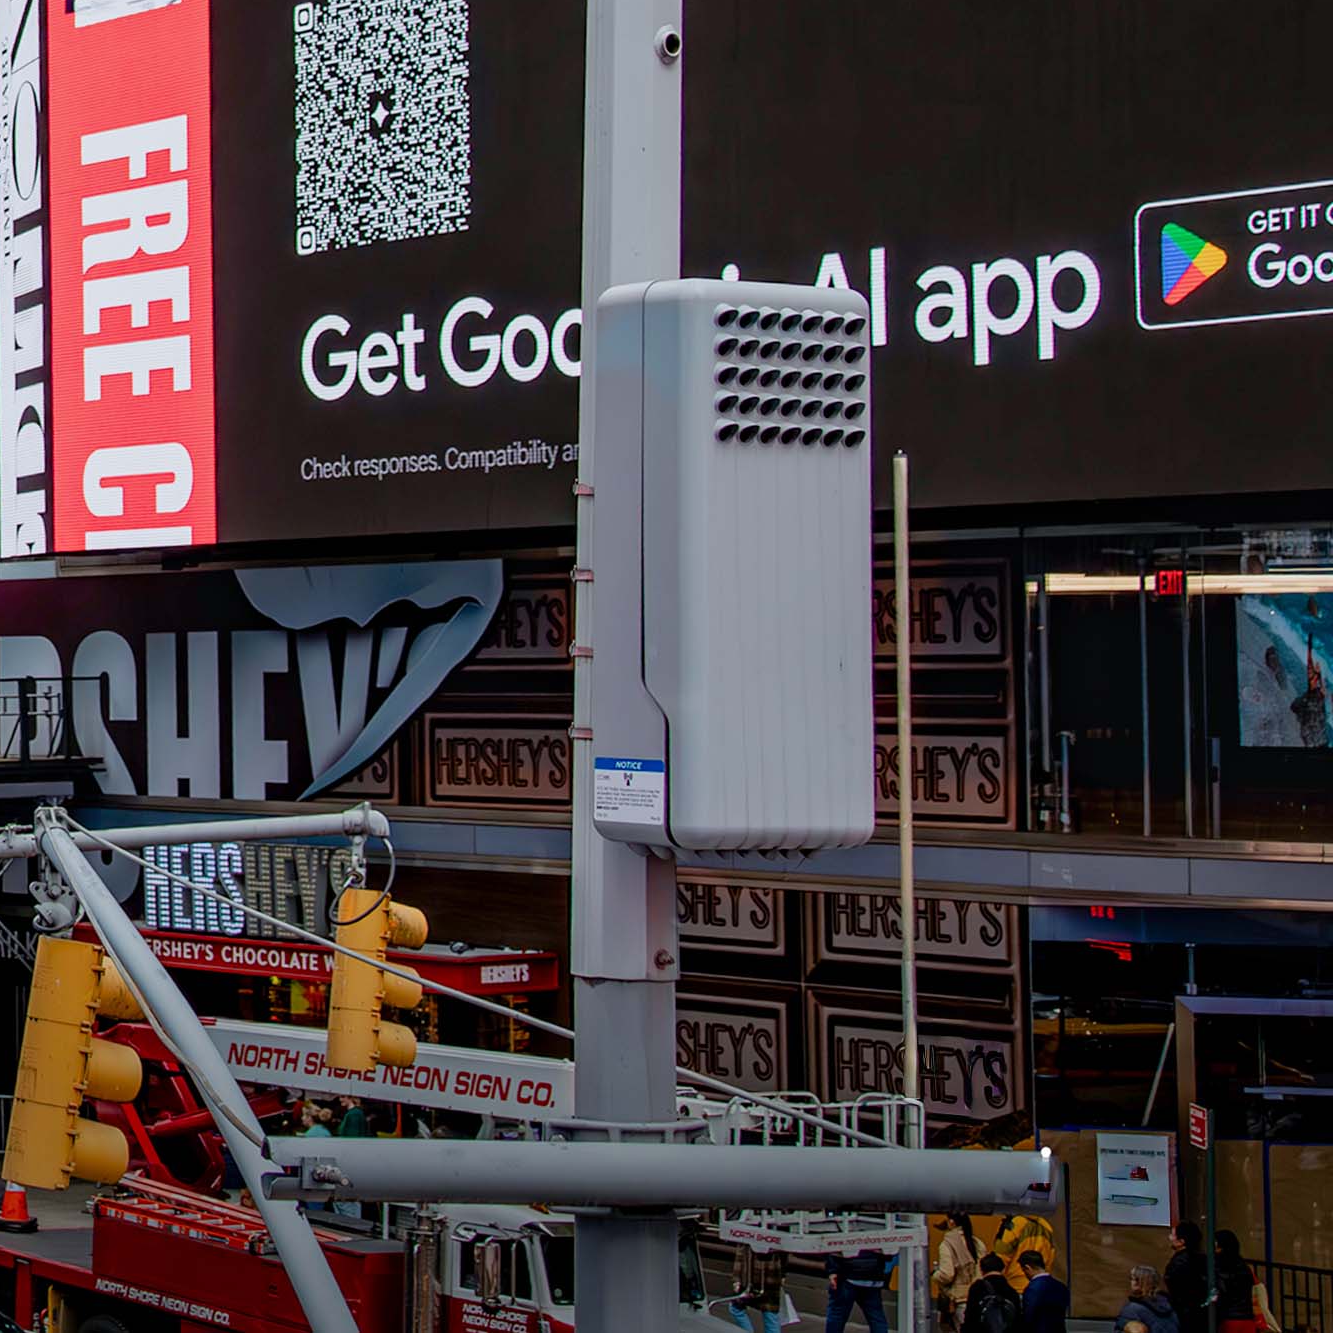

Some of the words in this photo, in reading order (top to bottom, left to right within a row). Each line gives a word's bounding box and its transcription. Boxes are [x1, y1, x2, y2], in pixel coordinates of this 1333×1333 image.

[1248, 209, 1294, 235] GET
[1299, 203, 1321, 229] IT
[80, 114, 190, 402] FREE
[915, 250, 1102, 366] app
[301, 313, 426, 401] Get
[439, 296, 582, 388] Goo
[301, 456, 351, 480] Check
[354, 451, 441, 480] responses.
[445, 439, 558, 473] Compatibility
[83, 442, 194, 551] C
[1159, 571, 1183, 595] EXIT
[436, 735, 567, 789] HERSHEY'S
[614, 761, 643, 770] NOTICE
[221, 945, 319, 972] CHOCOLATE
[227, 1042, 299, 1072] NORTH
[383, 1063, 448, 1092] NEON
[454, 1070, 511, 1101] SIGN
[517, 1079, 556, 1109] CO.
[730, 1229, 755, 1242] NORTH
[757, 1233, 782, 1245] SHORE
[96, 1278, 127, 1299] NORTH
[128, 1287, 159, 1307] SHORE
[160, 1295, 189, 1313] NEON
[190, 1302, 213, 1319] SIGN
[462, 1314, 488, 1328] NEON
[490, 1318, 511, 1331] SIGN
